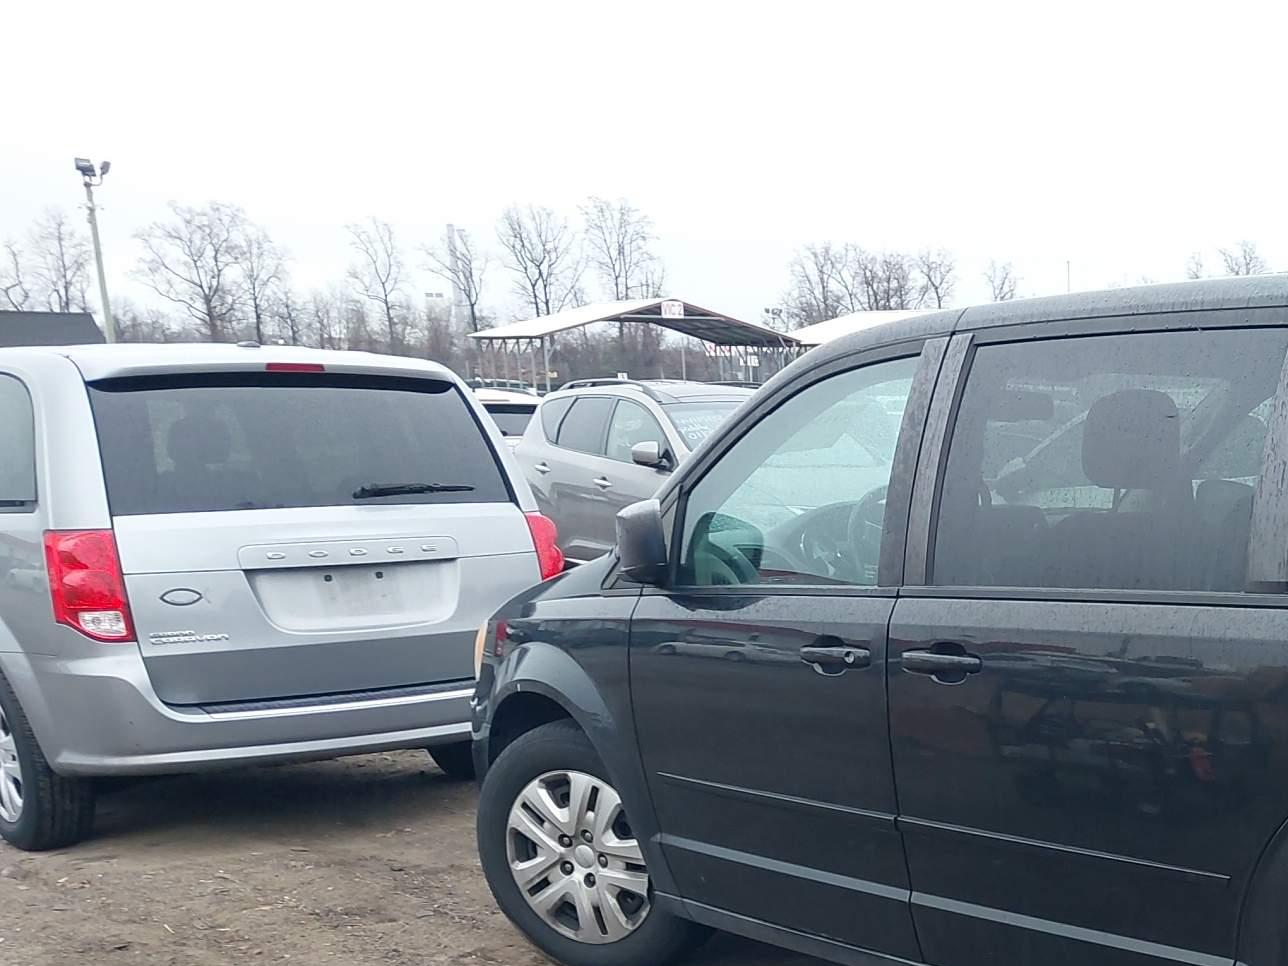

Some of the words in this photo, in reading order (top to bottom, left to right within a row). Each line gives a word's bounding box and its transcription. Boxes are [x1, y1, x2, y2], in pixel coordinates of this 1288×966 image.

[265, 544, 438, 560] DODGE
[149, 630, 196, 639] GRAND
[149, 634, 230, 646] CARAVAN
